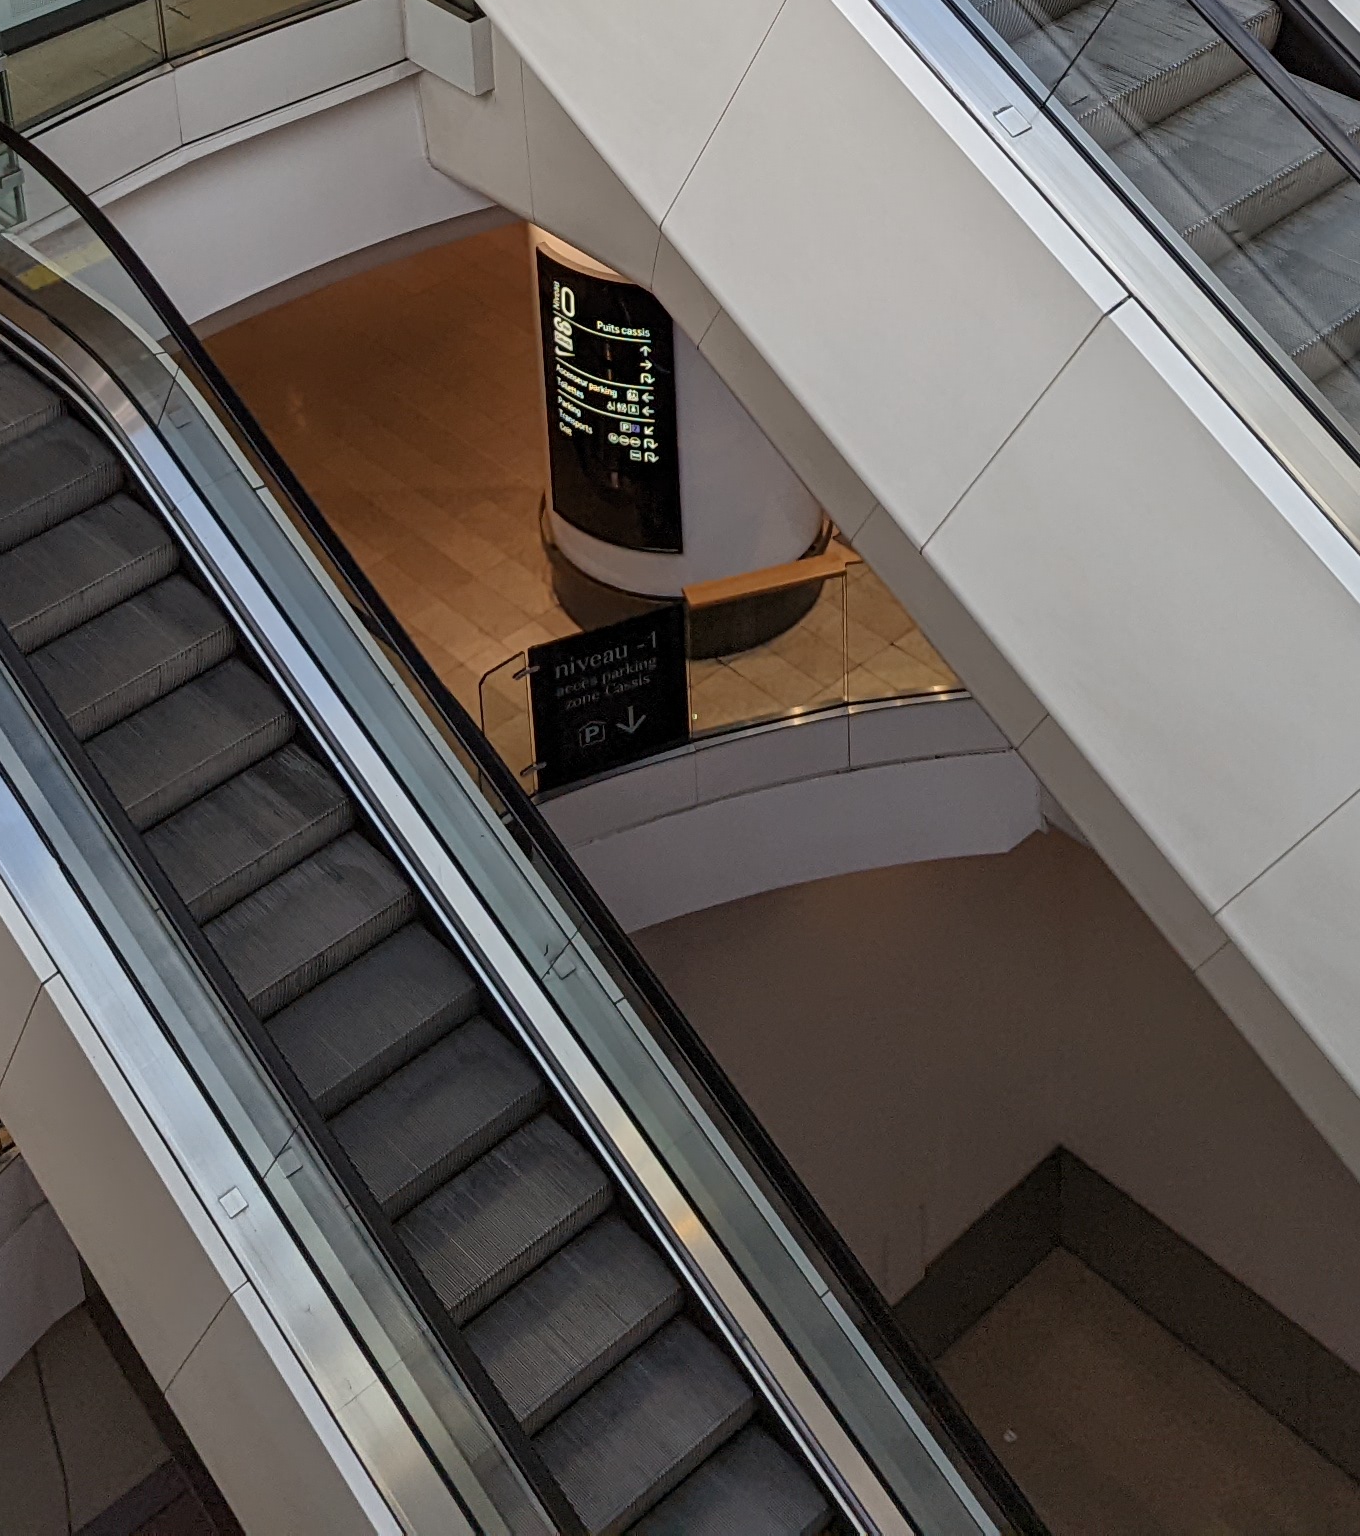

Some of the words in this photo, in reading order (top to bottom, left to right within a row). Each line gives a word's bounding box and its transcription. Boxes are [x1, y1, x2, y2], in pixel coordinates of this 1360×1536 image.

[596, 320, 621, 335] Puits
[621, 327, 651, 338] cassis
[554, 643, 629, 680] niveau
[636, 630, 658, 650] -1
[601, 656, 658, 686] parking
[565, 691, 601, 711] zone
[604, 672, 651, 697] Cassis
